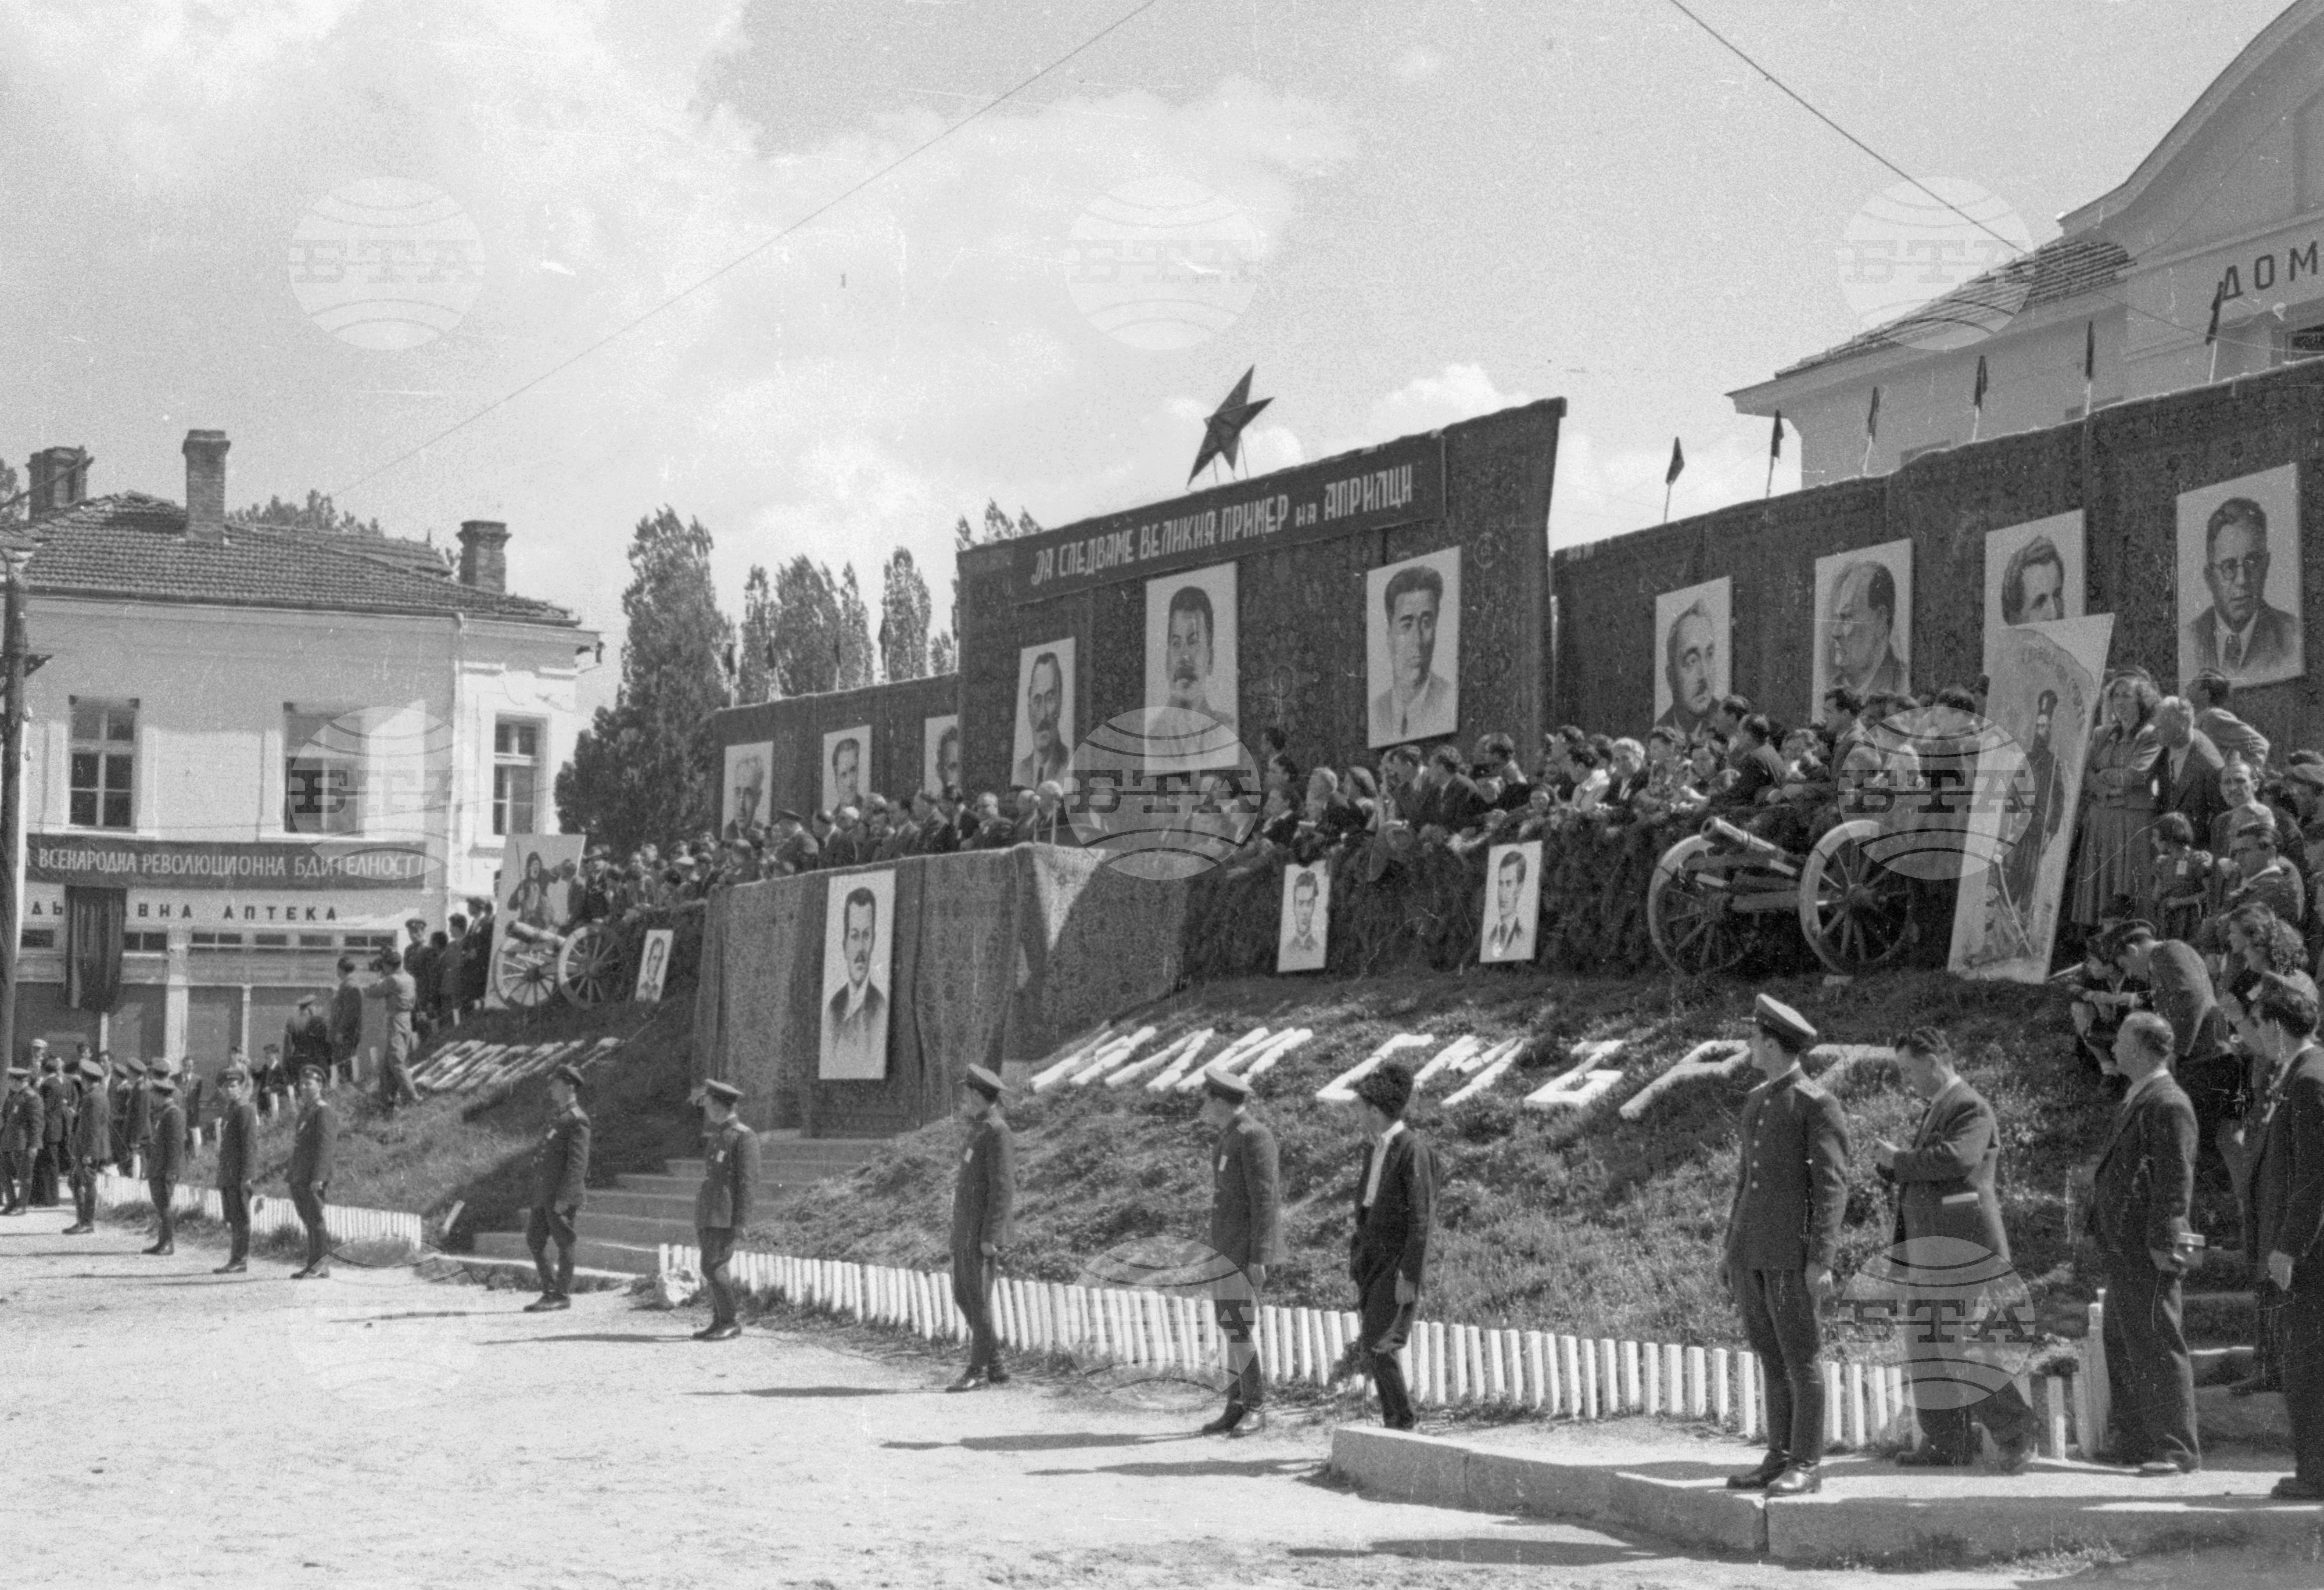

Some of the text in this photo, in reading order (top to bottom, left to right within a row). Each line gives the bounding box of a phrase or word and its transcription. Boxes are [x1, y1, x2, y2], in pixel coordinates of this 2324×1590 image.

[2222, 241, 2318, 301] ДОМ
[1058, 529, 1134, 577] СЛЕДВАМЕ
[1139, 511, 1216, 559] ВЕЛИКИЯ
[1221, 494, 1289, 543] ПРИМЕР
[1324, 464, 1412, 521] АПРИЛЦИ
[38, 848, 137, 873] ВСЕНАРОДНА
[142, 853, 286, 877] РЕВОЛЮЦИОННА
[31, 900, 336, 921] ДЪВНА АПТЕКА
